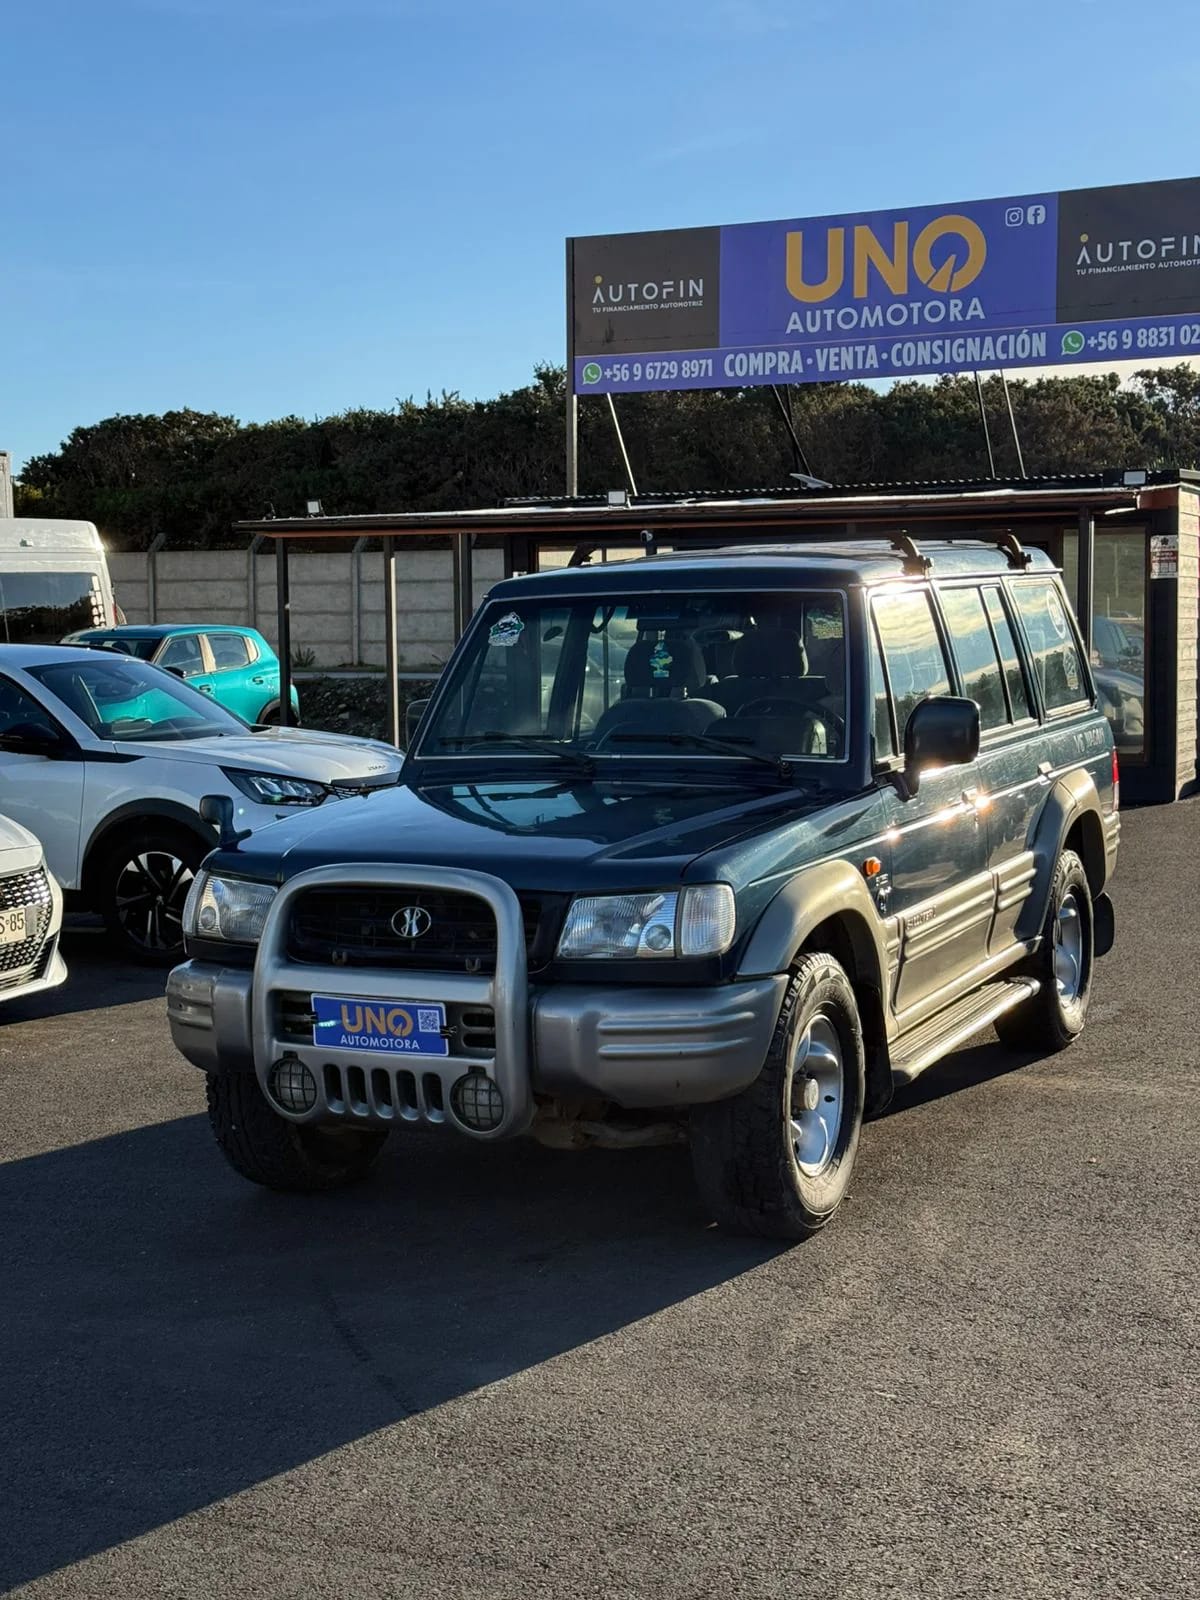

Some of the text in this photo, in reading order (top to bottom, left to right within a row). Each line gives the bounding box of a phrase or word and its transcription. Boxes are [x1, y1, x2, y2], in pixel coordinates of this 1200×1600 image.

[785, 214, 988, 303] UNO
[1076, 268, 1087, 276] TU
[1088, 262, 1157, 275] FINANCIAMIENTO
[592, 275, 704, 304] AUTOFIN
[602, 303, 659, 313] FINANCIAMIENTO
[660, 300, 703, 309] AUTOMOTRIZ
[785, 297, 986, 335] AUTOMOTORA
[1087, 324, 1200, 351] +56 9 8831 02
[724, 328, 1047, 377] COMPRA VENTA CONSIGNACIÓN
[604, 359, 713, 382] +56 9 6729 8971
[340, 1005, 413, 1037] UNO
[340, 1034, 420, 1050] AUTOMOTORA
